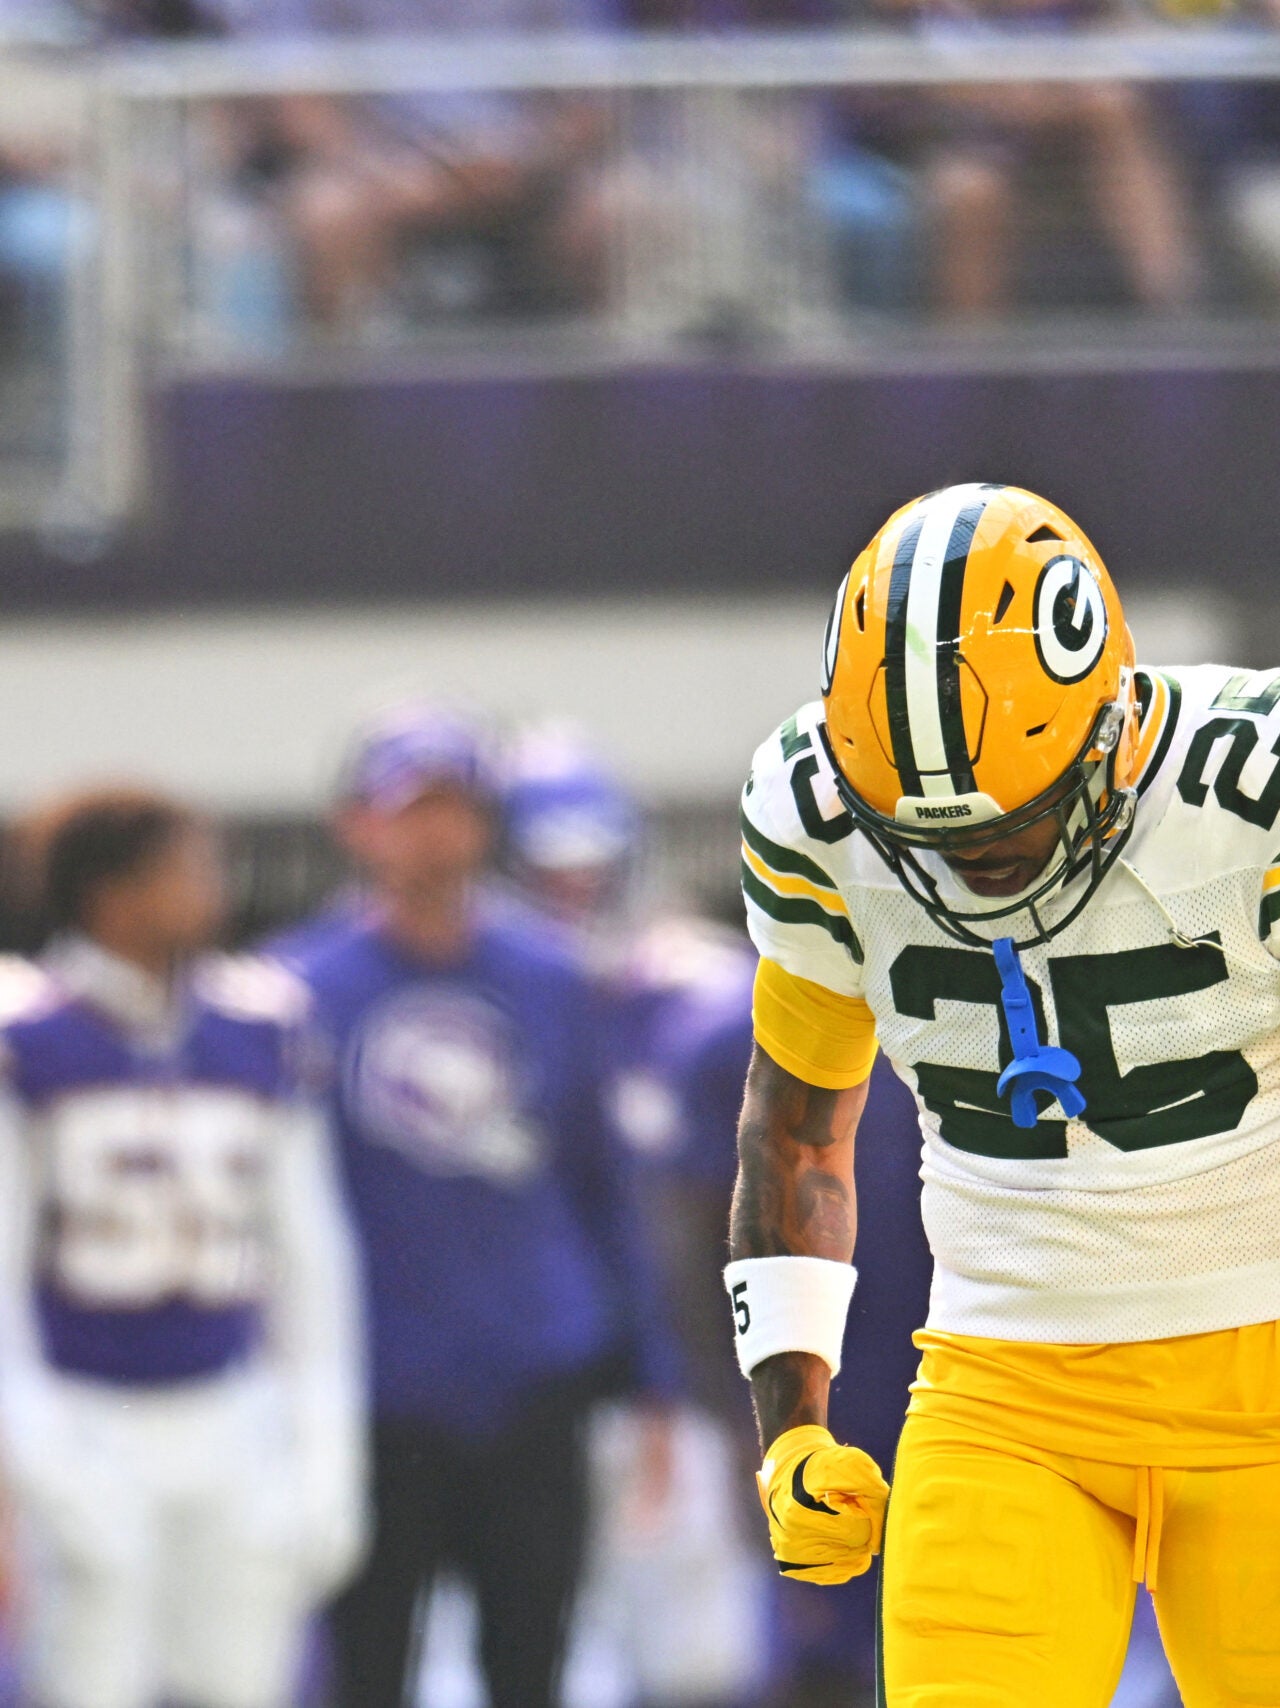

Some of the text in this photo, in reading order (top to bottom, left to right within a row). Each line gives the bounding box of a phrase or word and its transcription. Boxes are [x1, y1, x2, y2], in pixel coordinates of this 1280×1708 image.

[1038, 561, 1107, 678] G
[915, 804, 973, 819] PACKERS
[889, 931, 1259, 1159] 25
